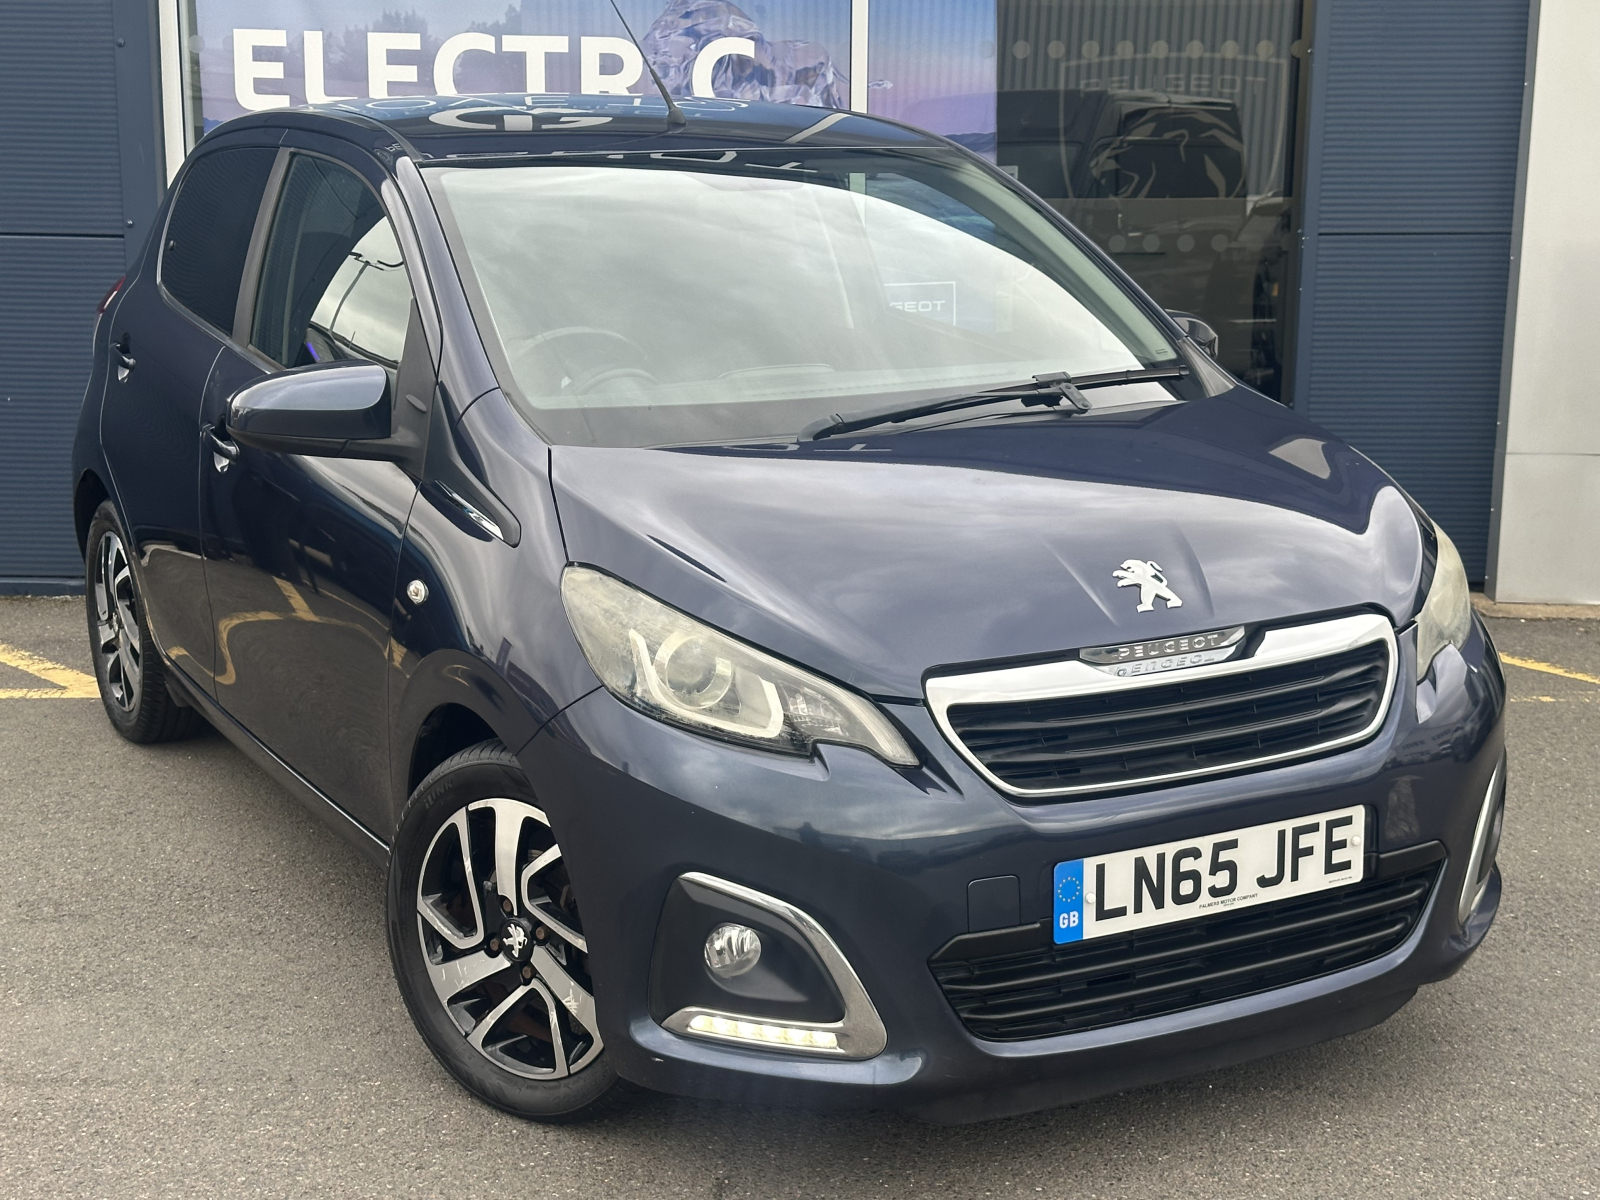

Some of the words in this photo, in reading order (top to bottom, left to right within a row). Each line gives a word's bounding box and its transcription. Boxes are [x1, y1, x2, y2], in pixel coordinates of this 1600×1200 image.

[233, 28, 755, 111] ELECTRC
[1118, 634, 1219, 660] PEUGEOT
[1095, 838, 1239, 922] LN65
[1256, 815, 1353, 889] JFE
[1199, 901, 1220, 909] PALMERS
[1236, 893, 1258, 901] COMPANY
[1059, 910, 1079, 929] GB
